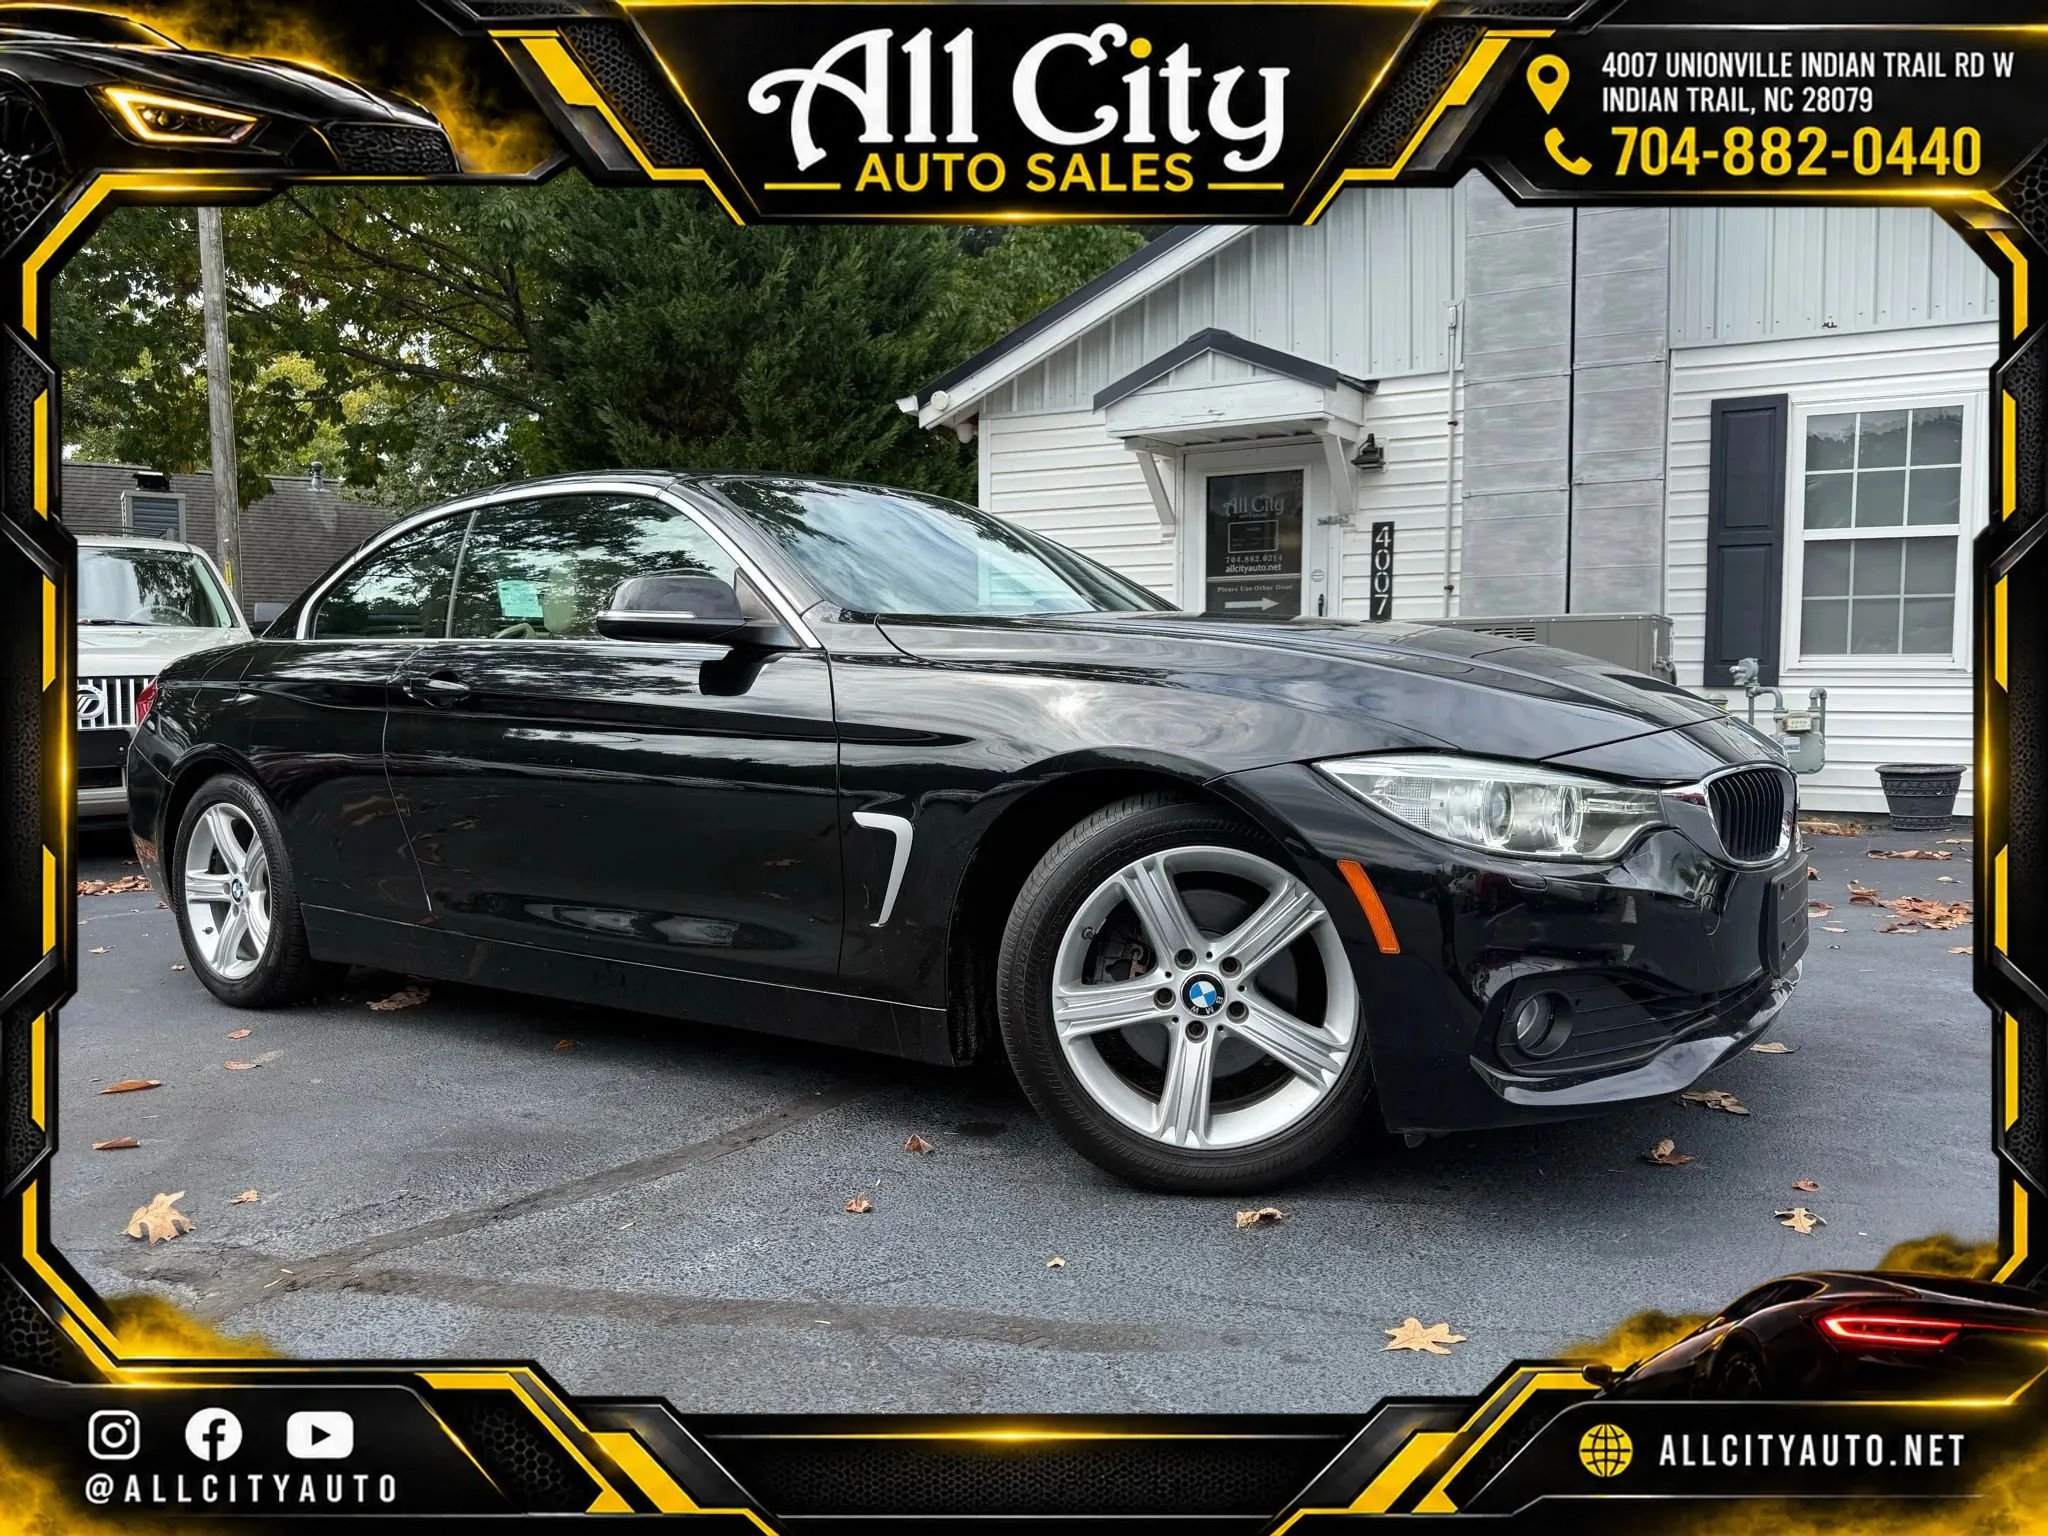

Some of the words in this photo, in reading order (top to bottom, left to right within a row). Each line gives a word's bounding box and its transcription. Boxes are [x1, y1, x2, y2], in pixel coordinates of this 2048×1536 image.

[1223, 497, 1248, 517] All
[1252, 495, 1284, 516] City
[1225, 563, 1282, 575] allcityauto.net
[1374, 525, 1392, 616] 4007
